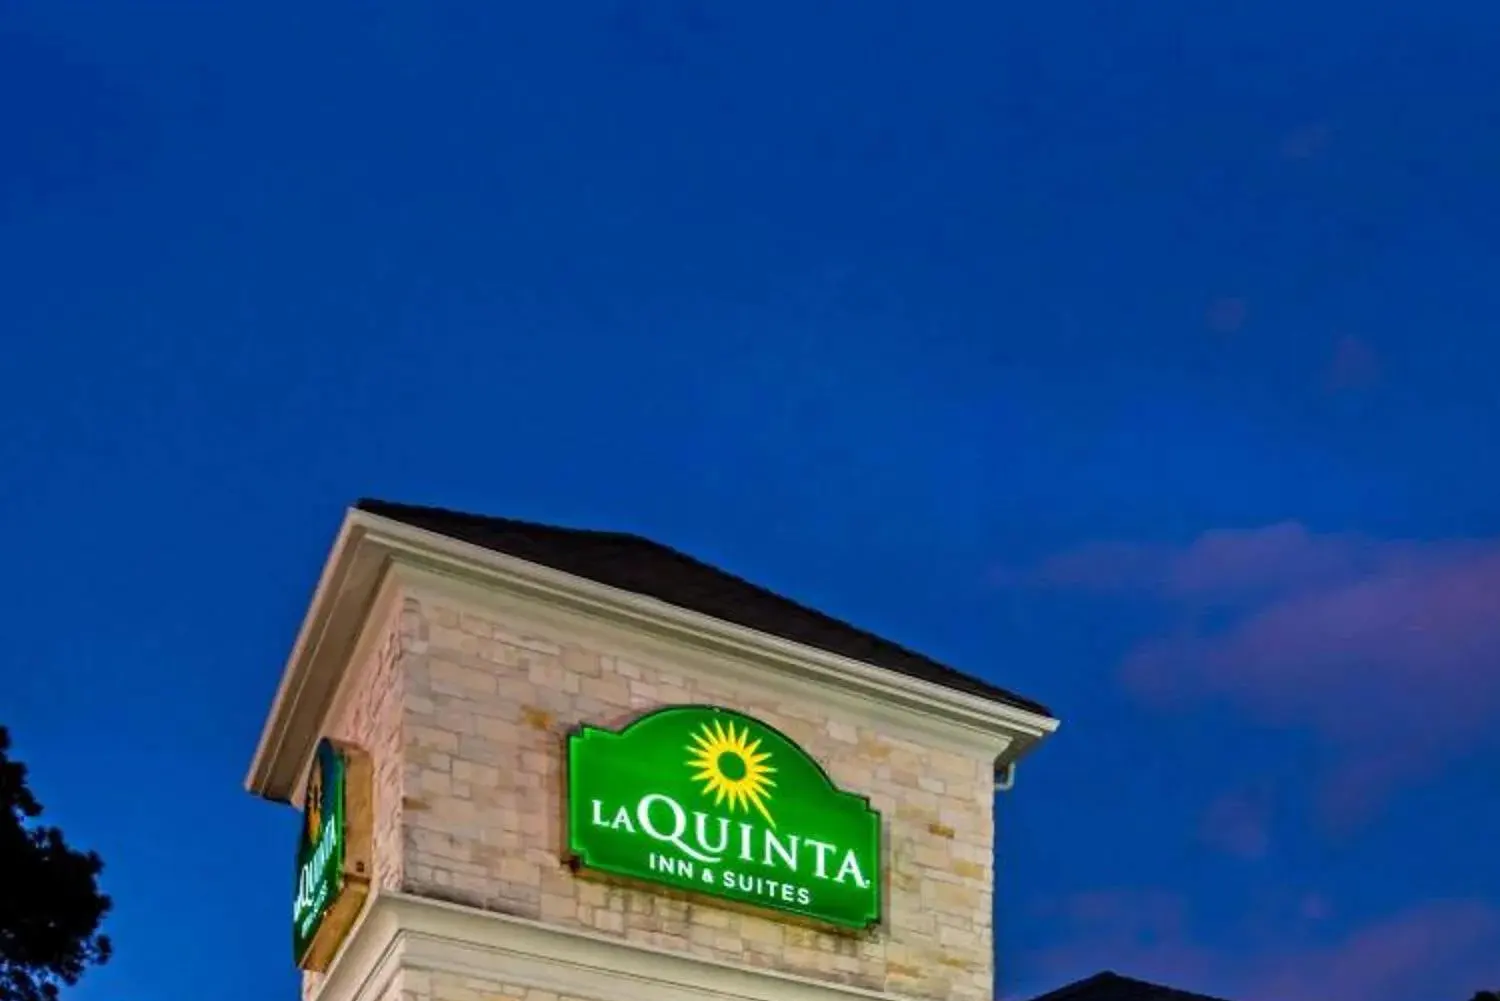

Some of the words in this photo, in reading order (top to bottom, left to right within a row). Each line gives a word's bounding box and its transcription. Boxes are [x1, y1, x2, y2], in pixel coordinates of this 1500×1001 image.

[592, 799, 636, 833] LA
[637, 794, 868, 888] QUINTA
[649, 852, 694, 879] INN
[701, 868, 714, 884] &
[723, 871, 811, 905] SUITES
